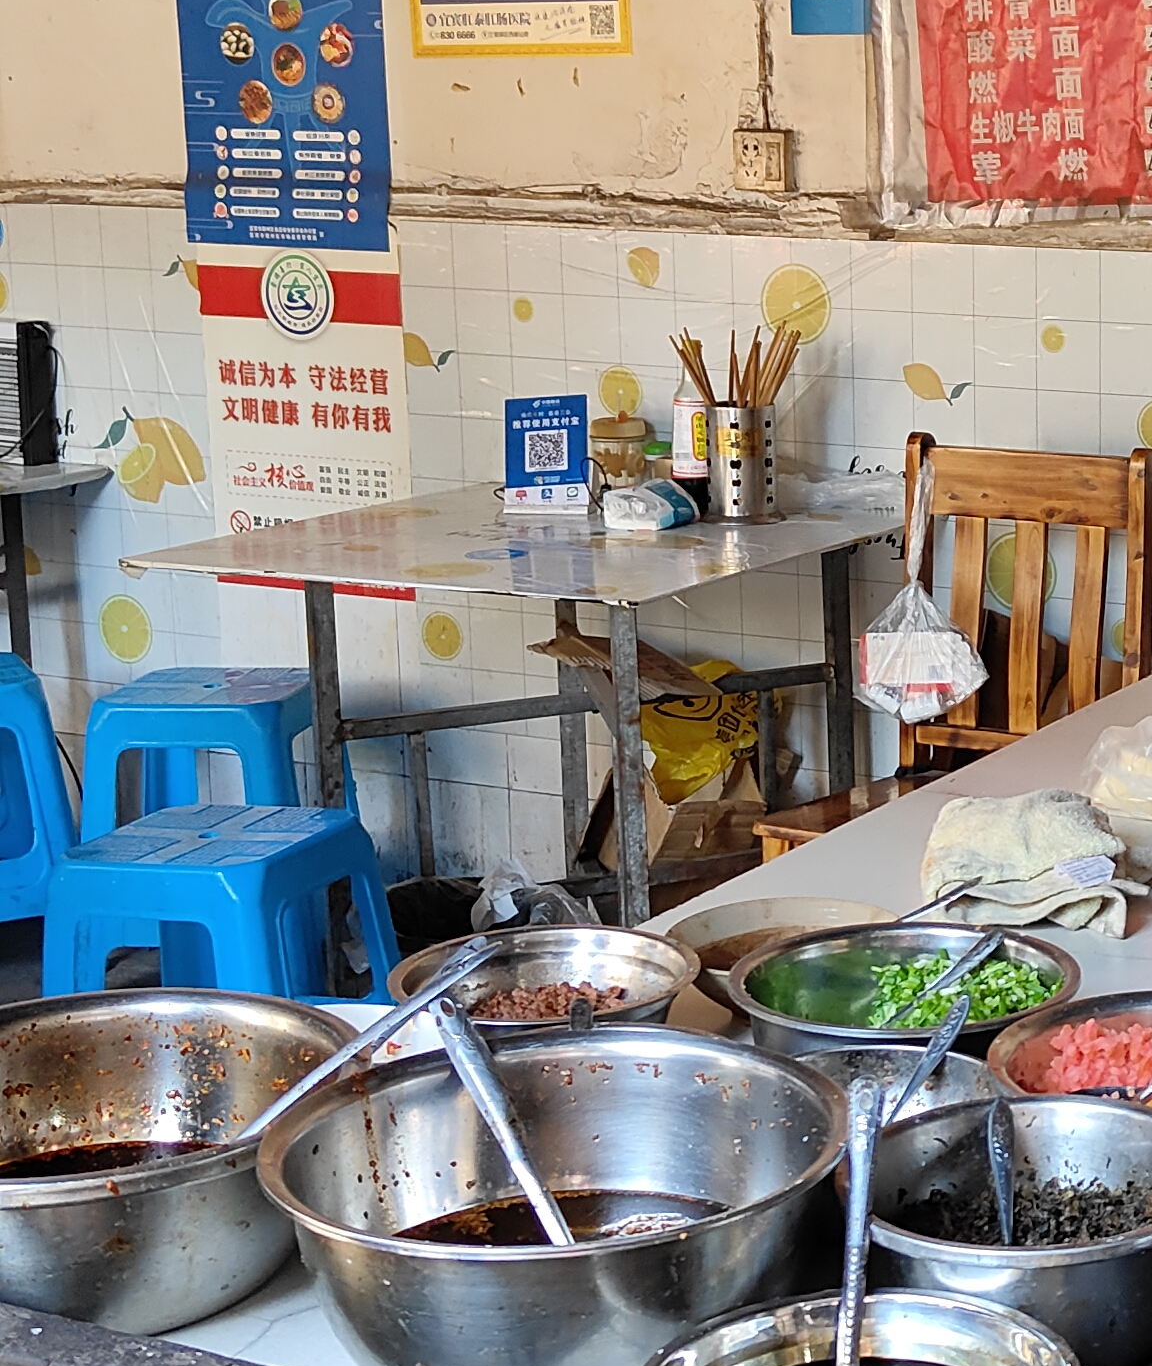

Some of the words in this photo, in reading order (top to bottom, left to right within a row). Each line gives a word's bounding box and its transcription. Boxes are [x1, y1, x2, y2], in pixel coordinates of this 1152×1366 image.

[966, 25, 1080, 64] 酸菜面
[970, 108, 1085, 145] 生椒牛肉面
[218, 358, 298, 390] 诚信为本
[307, 363, 389, 396] 守法经营
[221, 395, 300, 427] 文明健康
[310, 401, 392, 434] 有你有我
[512, 416, 580, 430] 推荐使用支付宝
[232, 474, 267, 488] 社会主义
[263, 461, 307, 490] 核心
[288, 479, 315, 493] 价值观
[356, 478, 370, 487] 公正
